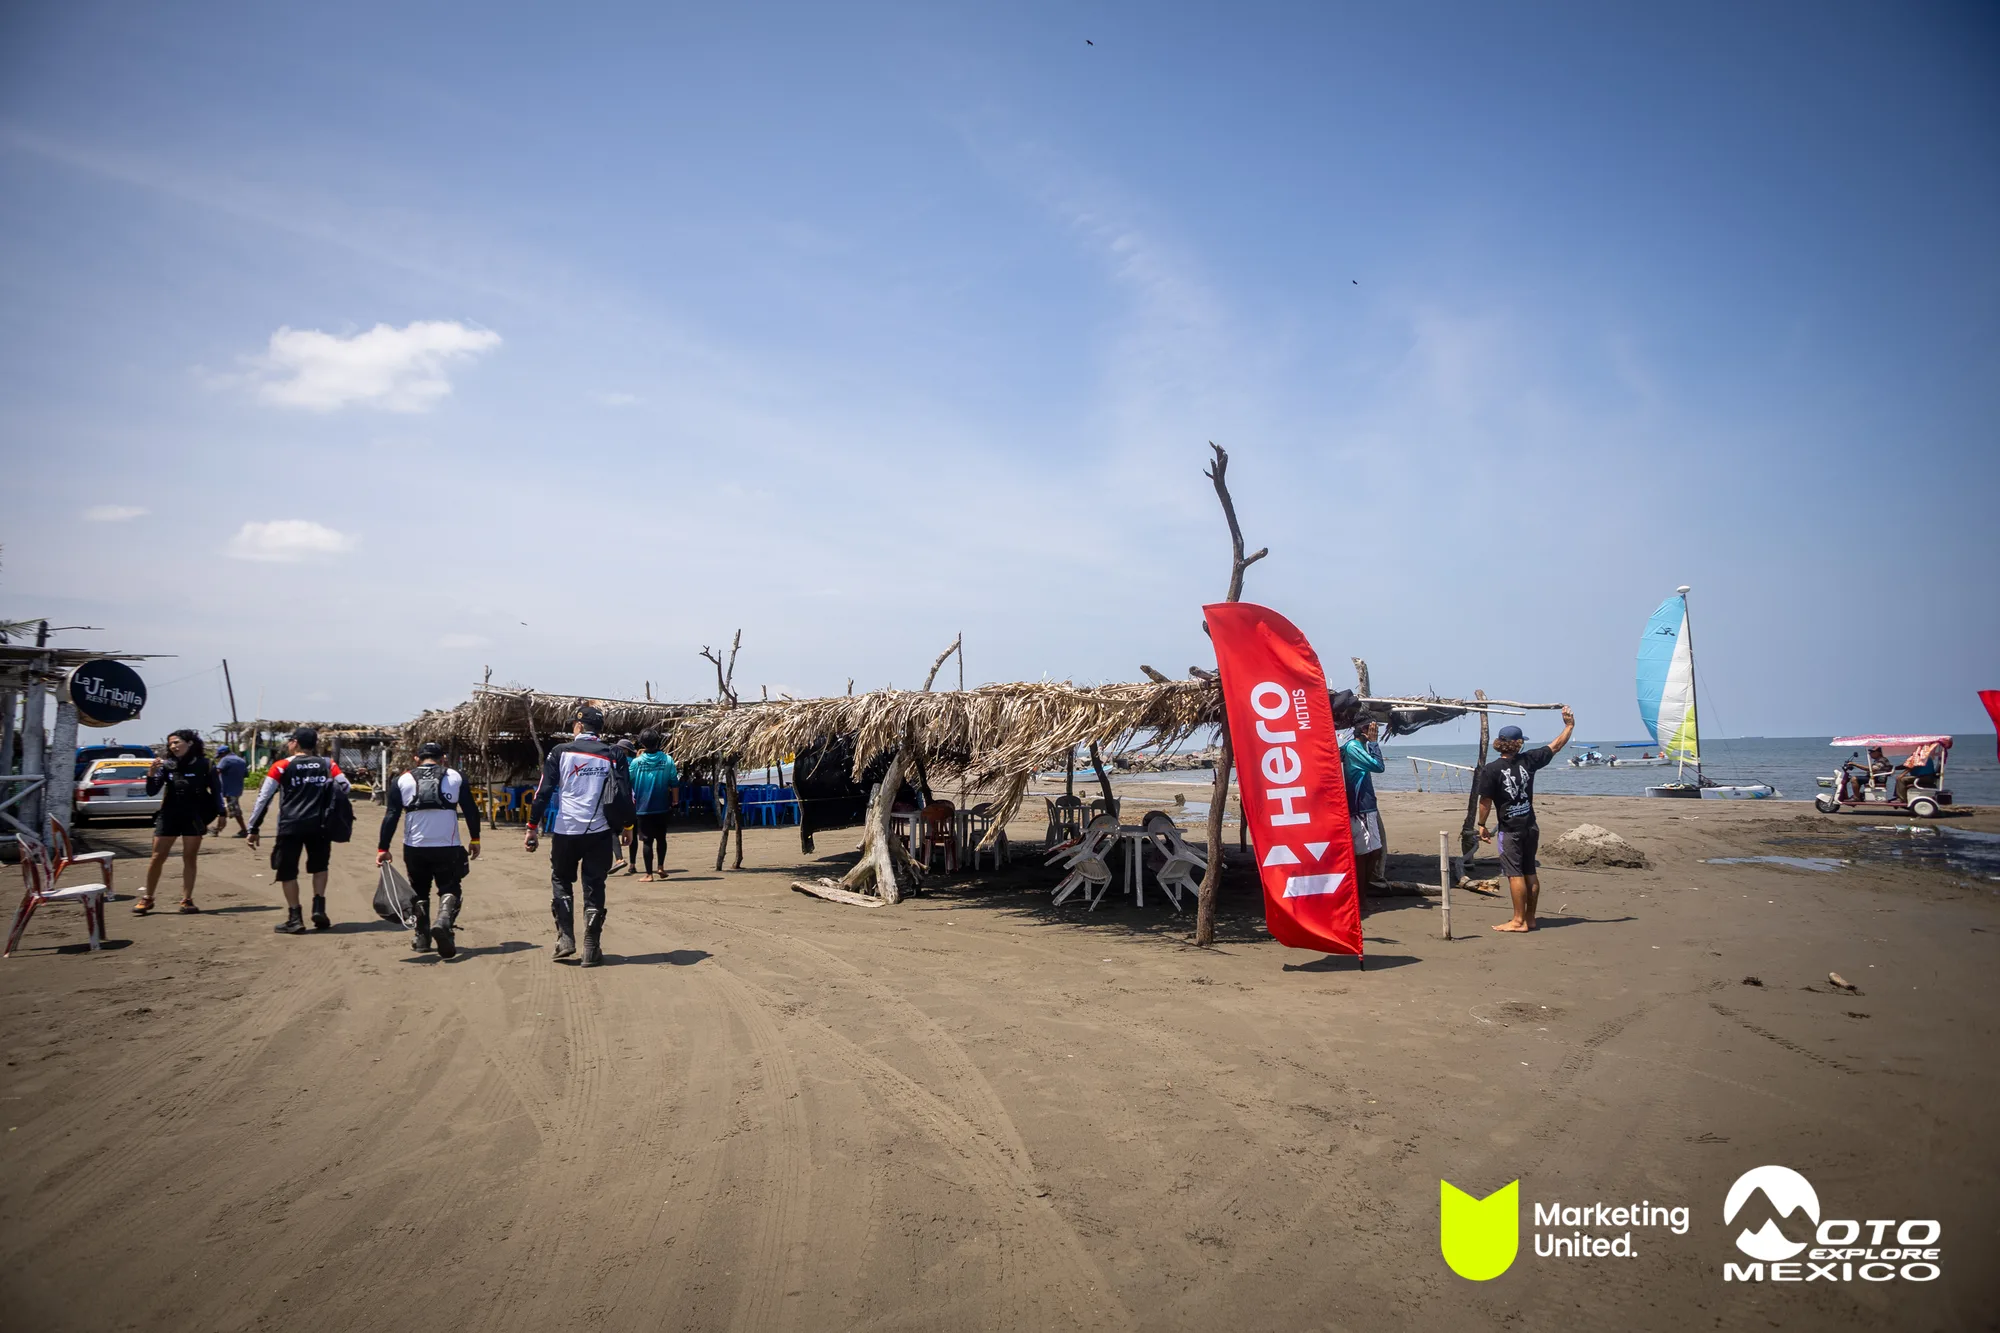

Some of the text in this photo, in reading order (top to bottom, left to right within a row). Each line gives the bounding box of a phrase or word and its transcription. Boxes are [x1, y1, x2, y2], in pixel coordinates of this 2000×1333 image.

[74, 672, 143, 706] La Jiribilla
[86, 694, 129, 710] REST BAR
[1291, 688, 1312, 730] MOTOS
[296, 762, 321, 770] PACO
[1250, 681, 1311, 827] Hero
[302, 775, 327, 784] Hero
